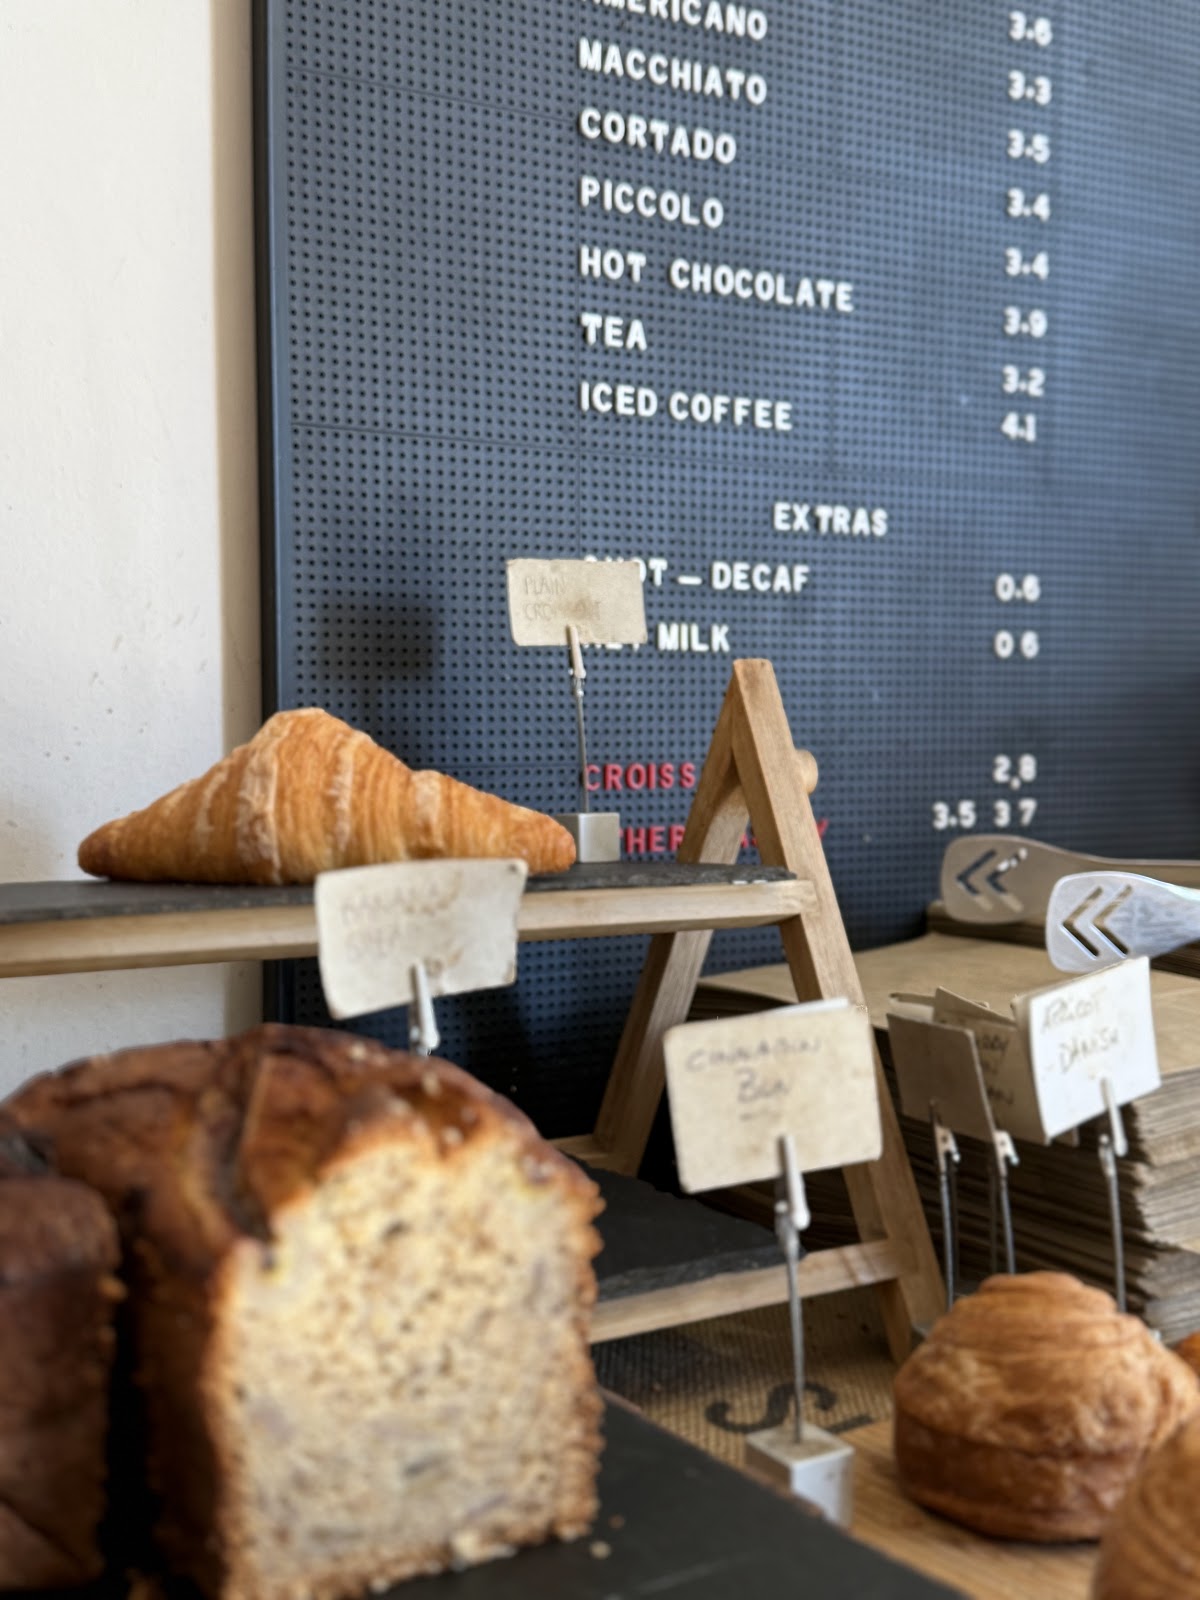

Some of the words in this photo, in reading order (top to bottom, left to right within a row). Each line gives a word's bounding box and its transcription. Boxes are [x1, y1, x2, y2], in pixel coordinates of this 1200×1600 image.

[580, 0, 768, 40] RICANO
[1008, 69, 1052, 105] 3.3
[579, 37, 768, 105] MACCHIATO
[1007, 129, 1050, 164] 3.5
[579, 107, 737, 164] CORTADO
[1007, 187, 1050, 222] 3.4
[580, 175, 724, 228] PICCOLO
[1005, 247, 1049, 280] 3.4
[580, 245, 646, 282] HOT
[670, 258, 854, 312] CHOCOLATE
[580, 312, 647, 350] TEA
[1003, 364, 1045, 397] 3.2
[580, 382, 658, 417] ICED
[670, 391, 793, 431] COFFEE
[711, 561, 811, 592] DECAF
[996, 574, 1040, 602] 0.6
[657, 622, 731, 652] MILK
[585, 762, 697, 791] CROISS
[618, 825, 686, 854] HER
[932, 800, 976, 830] 3.5
